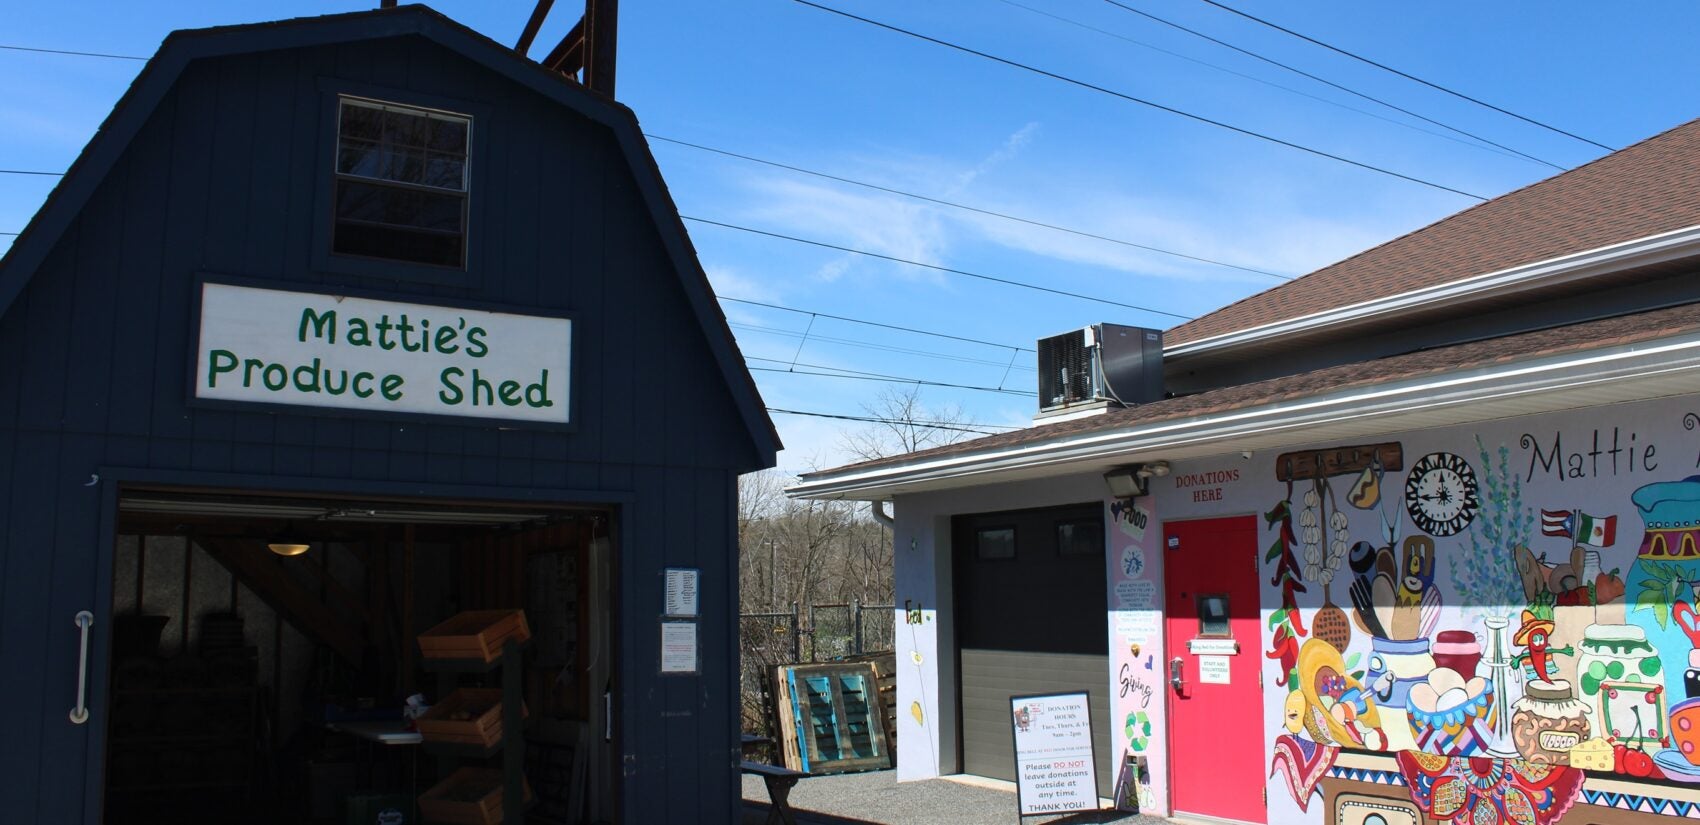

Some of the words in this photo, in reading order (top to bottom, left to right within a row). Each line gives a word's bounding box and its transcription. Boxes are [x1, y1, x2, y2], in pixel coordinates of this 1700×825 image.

[298, 307, 489, 358] Mattie's
[208, 349, 405, 401] Produce
[438, 366, 553, 408] Shed
[1519, 426, 1658, 483] Mattie
[1175, 469, 1240, 489] DONATIONS
[1193, 488, 1223, 503] HERE
[1119, 663, 1153, 709] Giving
[1029, 803, 1060, 811] THANK
[1038, 791, 1053, 799] any
